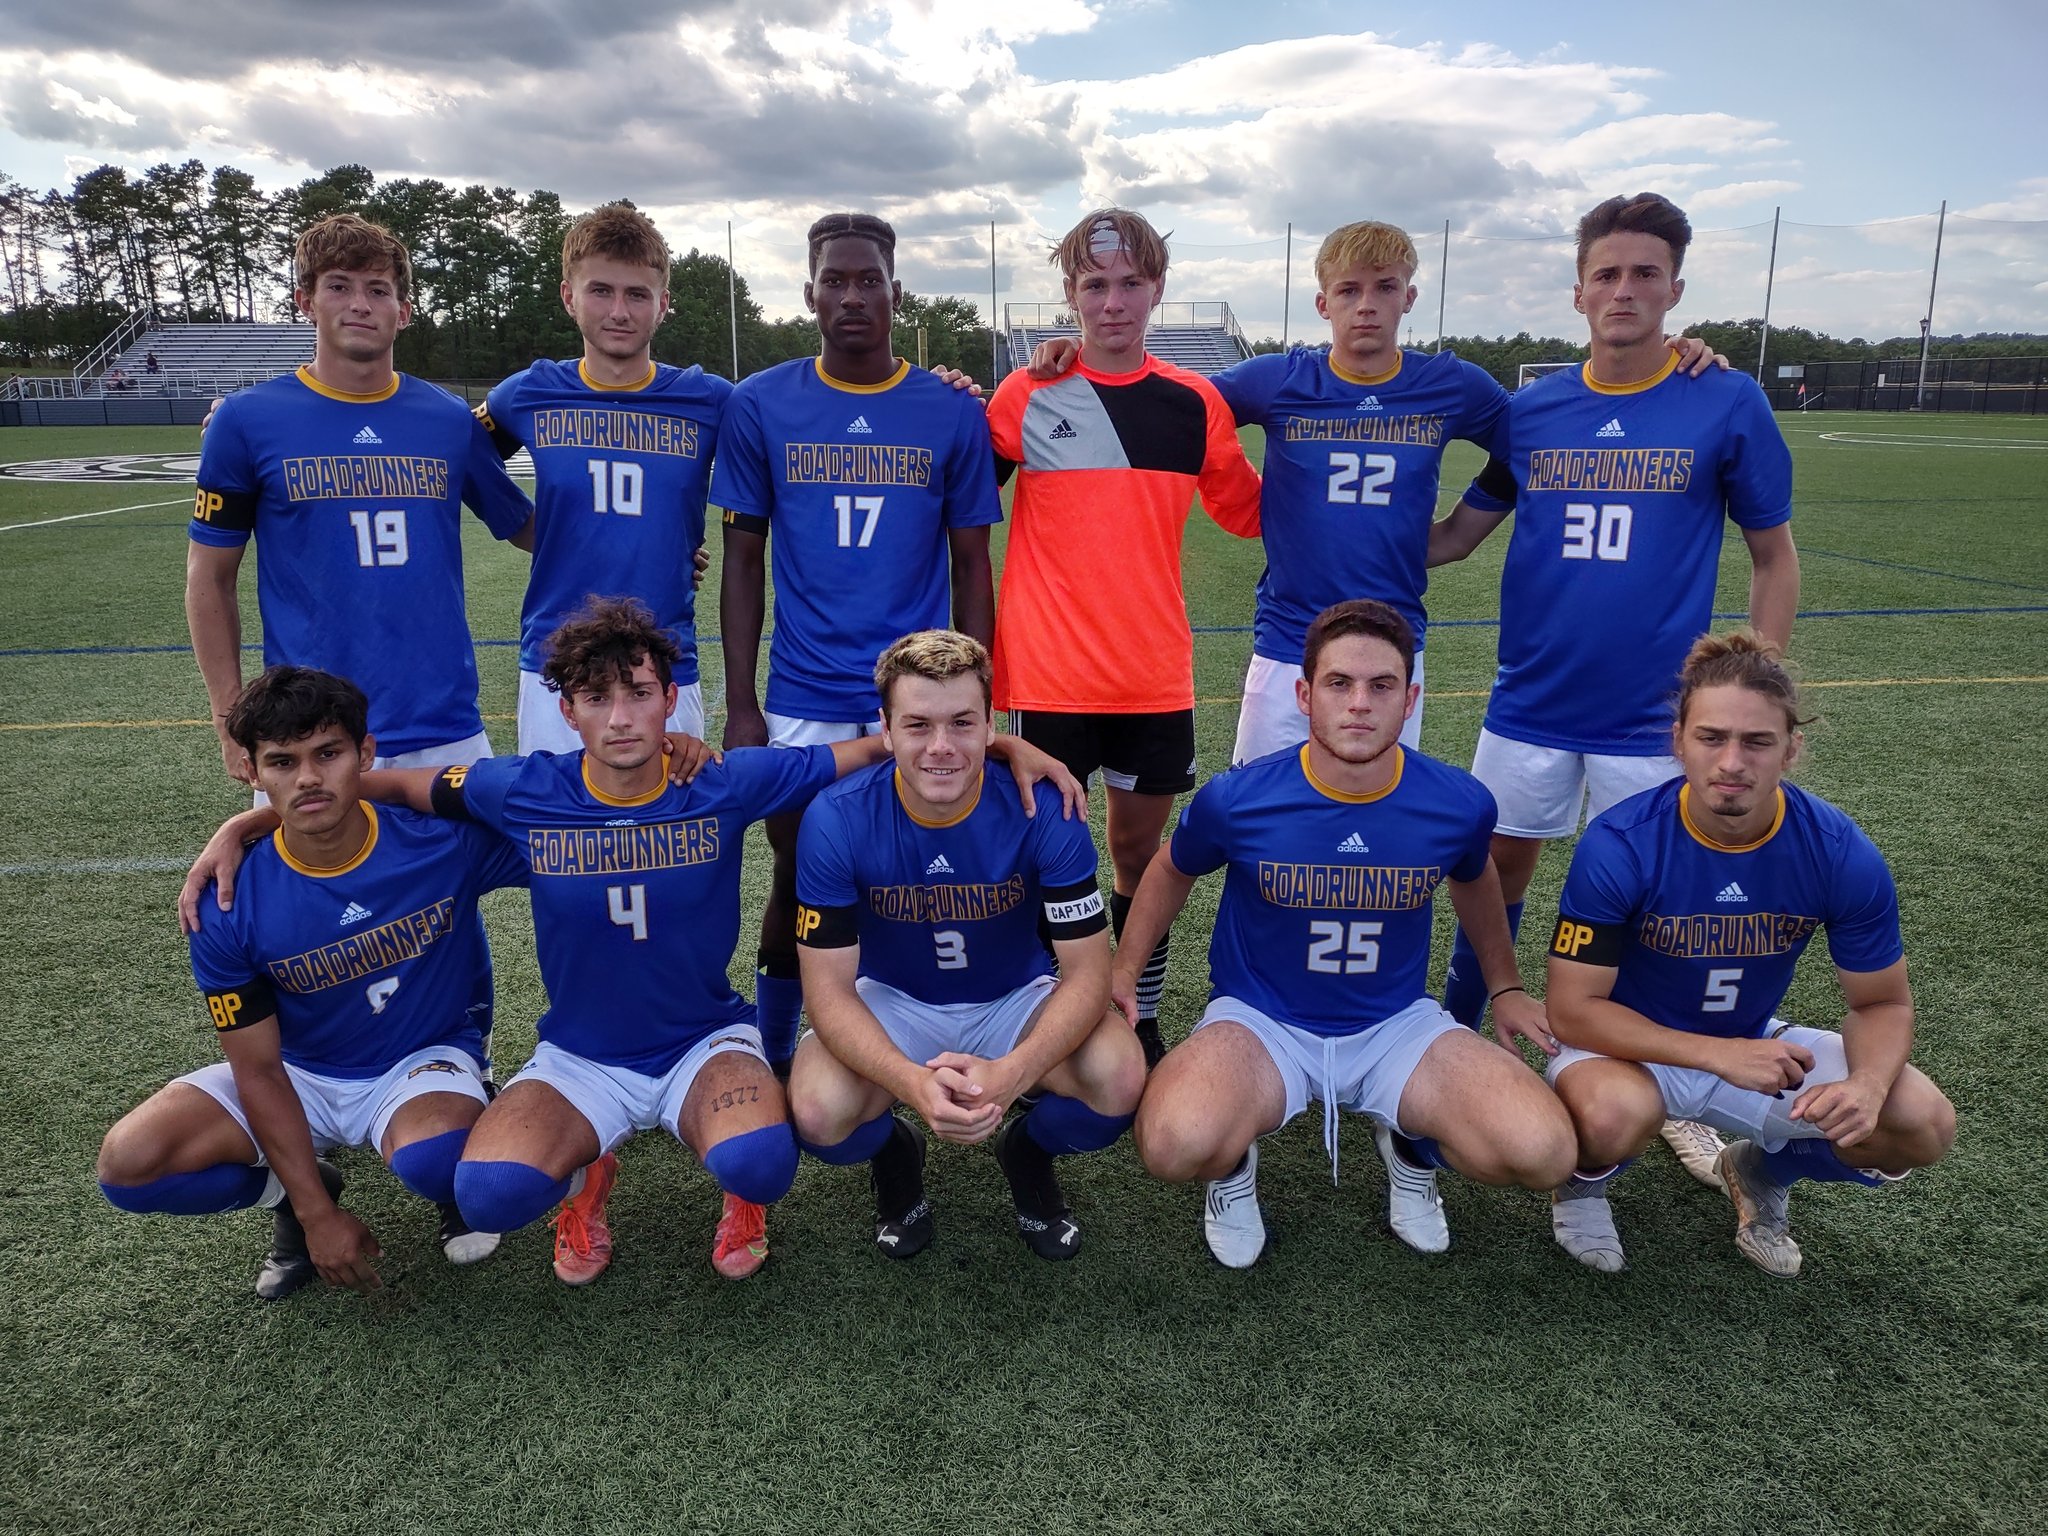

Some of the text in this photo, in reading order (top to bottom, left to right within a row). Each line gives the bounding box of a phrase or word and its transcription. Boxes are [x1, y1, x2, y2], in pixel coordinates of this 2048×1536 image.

[1356, 403, 1383, 411] adidas
[353, 435, 383, 445] adidas
[533, 409, 699, 459] ROADRUNNERS
[847, 426, 872, 434] adidas
[1049, 430, 1077, 440] adidas
[1285, 413, 1447, 448] ROADRUNNERS
[1596, 429, 1625, 437] adidas
[282, 455, 448, 502] ROADRUNNERS
[785, 443, 932, 487] ROADRUNNERS
[1327, 452, 1396, 506] 22
[1527, 448, 1695, 493] ROADRUNNERS
[193, 488, 224, 522] BP
[588, 459, 644, 516] 10
[350, 510, 410, 567] 19
[833, 495, 885, 548] 17
[1562, 503, 1633, 562] 30
[528, 817, 720, 876] ROADRUNNERS
[1337, 845, 1369, 853] adidas
[926, 865, 954, 875] adidas
[1258, 861, 1440, 911] ROADRUNNERS
[339, 909, 372, 926] adidas
[607, 884, 648, 940] 4
[869, 874, 1026, 923] ROADRUNNERS
[1051, 895, 1101, 920] CAPTAIN
[1715, 894, 1748, 902] adidas
[796, 905, 821, 940] BP
[1554, 921, 1594, 957] BP
[1639, 912, 1820, 958] ROADRUNNERS
[268, 896, 455, 994] ROADRUNNERS
[933, 930, 968, 970] 3
[1307, 920, 1383, 974] 25
[208, 993, 242, 1027] BP
[1701, 968, 1744, 1012] 5
[711, 1086, 760, 1113] 1977
